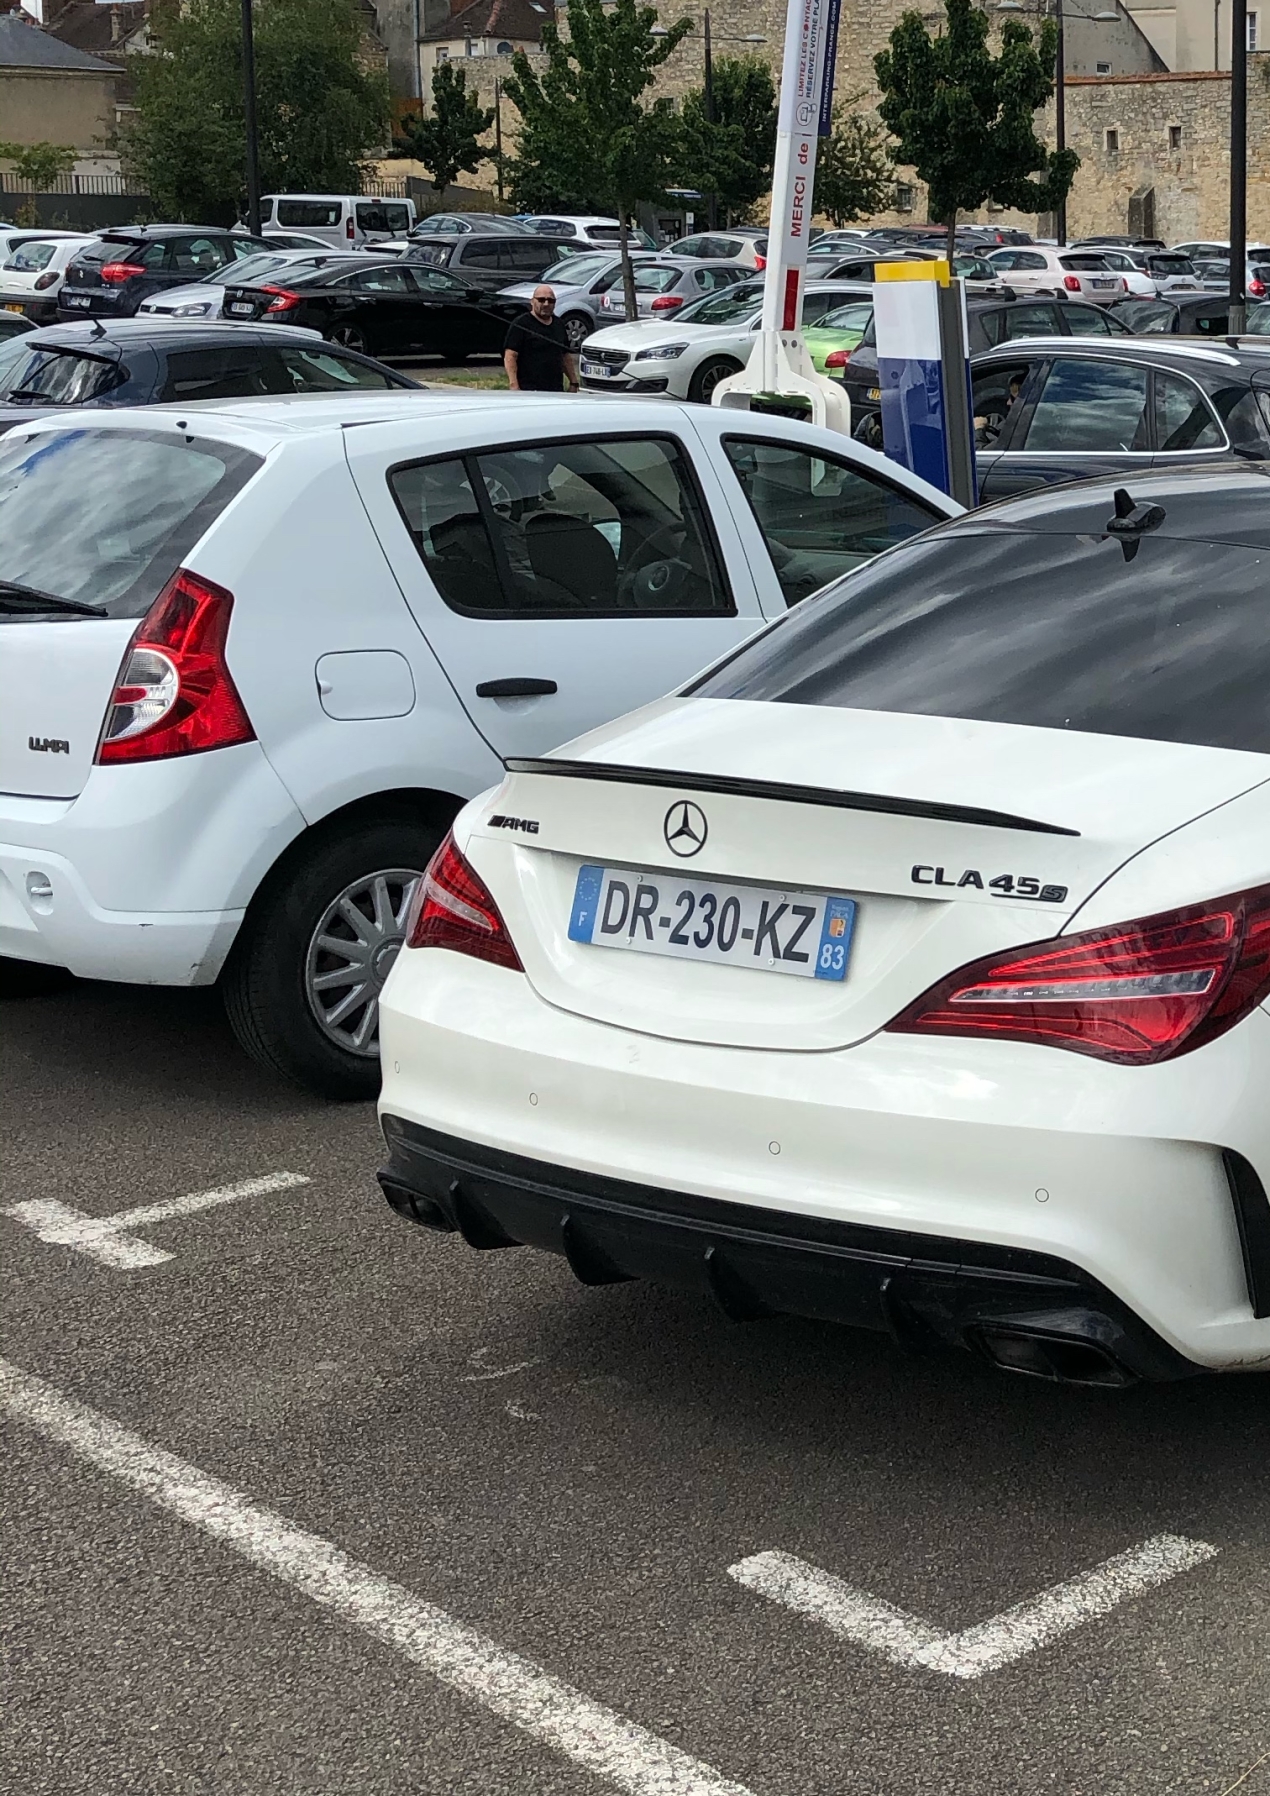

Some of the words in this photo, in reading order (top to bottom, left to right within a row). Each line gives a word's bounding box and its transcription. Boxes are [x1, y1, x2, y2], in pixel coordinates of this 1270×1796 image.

[810, 19, 818, 48] VOTRE
[798, 61, 806, 97] LIMITEZ
[806, 50, 815, 98] RÉSERVEZ
[797, 143, 809, 165] de
[791, 176, 806, 237] MERCI
[500, 816, 540, 834] AMG
[578, 911, 588, 927] F
[600, 880, 817, 963] DR-230-KZ
[820, 943, 845, 970] 83
